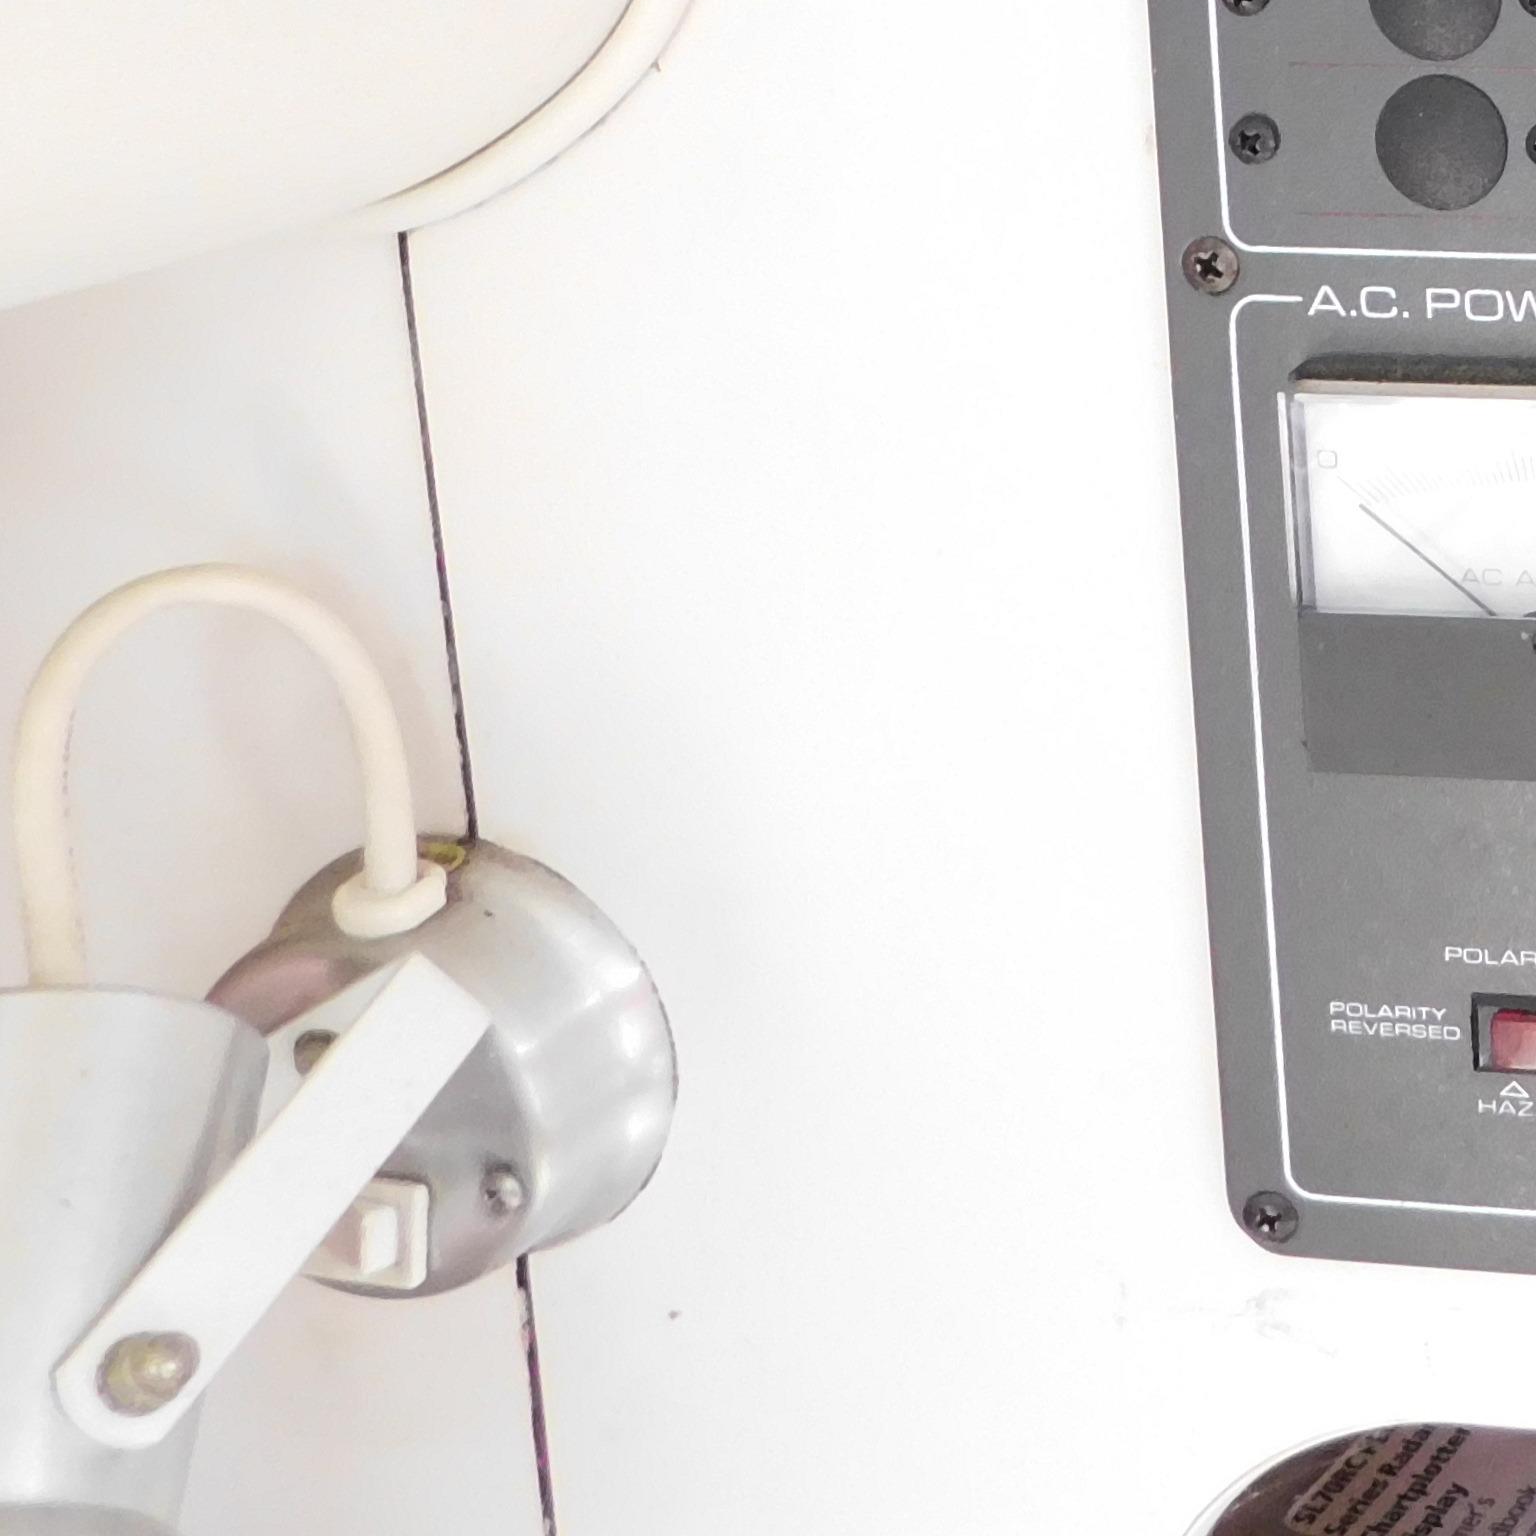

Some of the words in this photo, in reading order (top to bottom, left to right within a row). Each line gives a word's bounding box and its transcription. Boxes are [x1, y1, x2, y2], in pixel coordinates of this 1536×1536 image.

[1307, 284, 1410, 319] A.C.
[1458, 567, 1505, 587] AC
[1329, 1001, 1447, 1021] POLARITY
[1330, 1019, 1461, 1041] REVERSED
